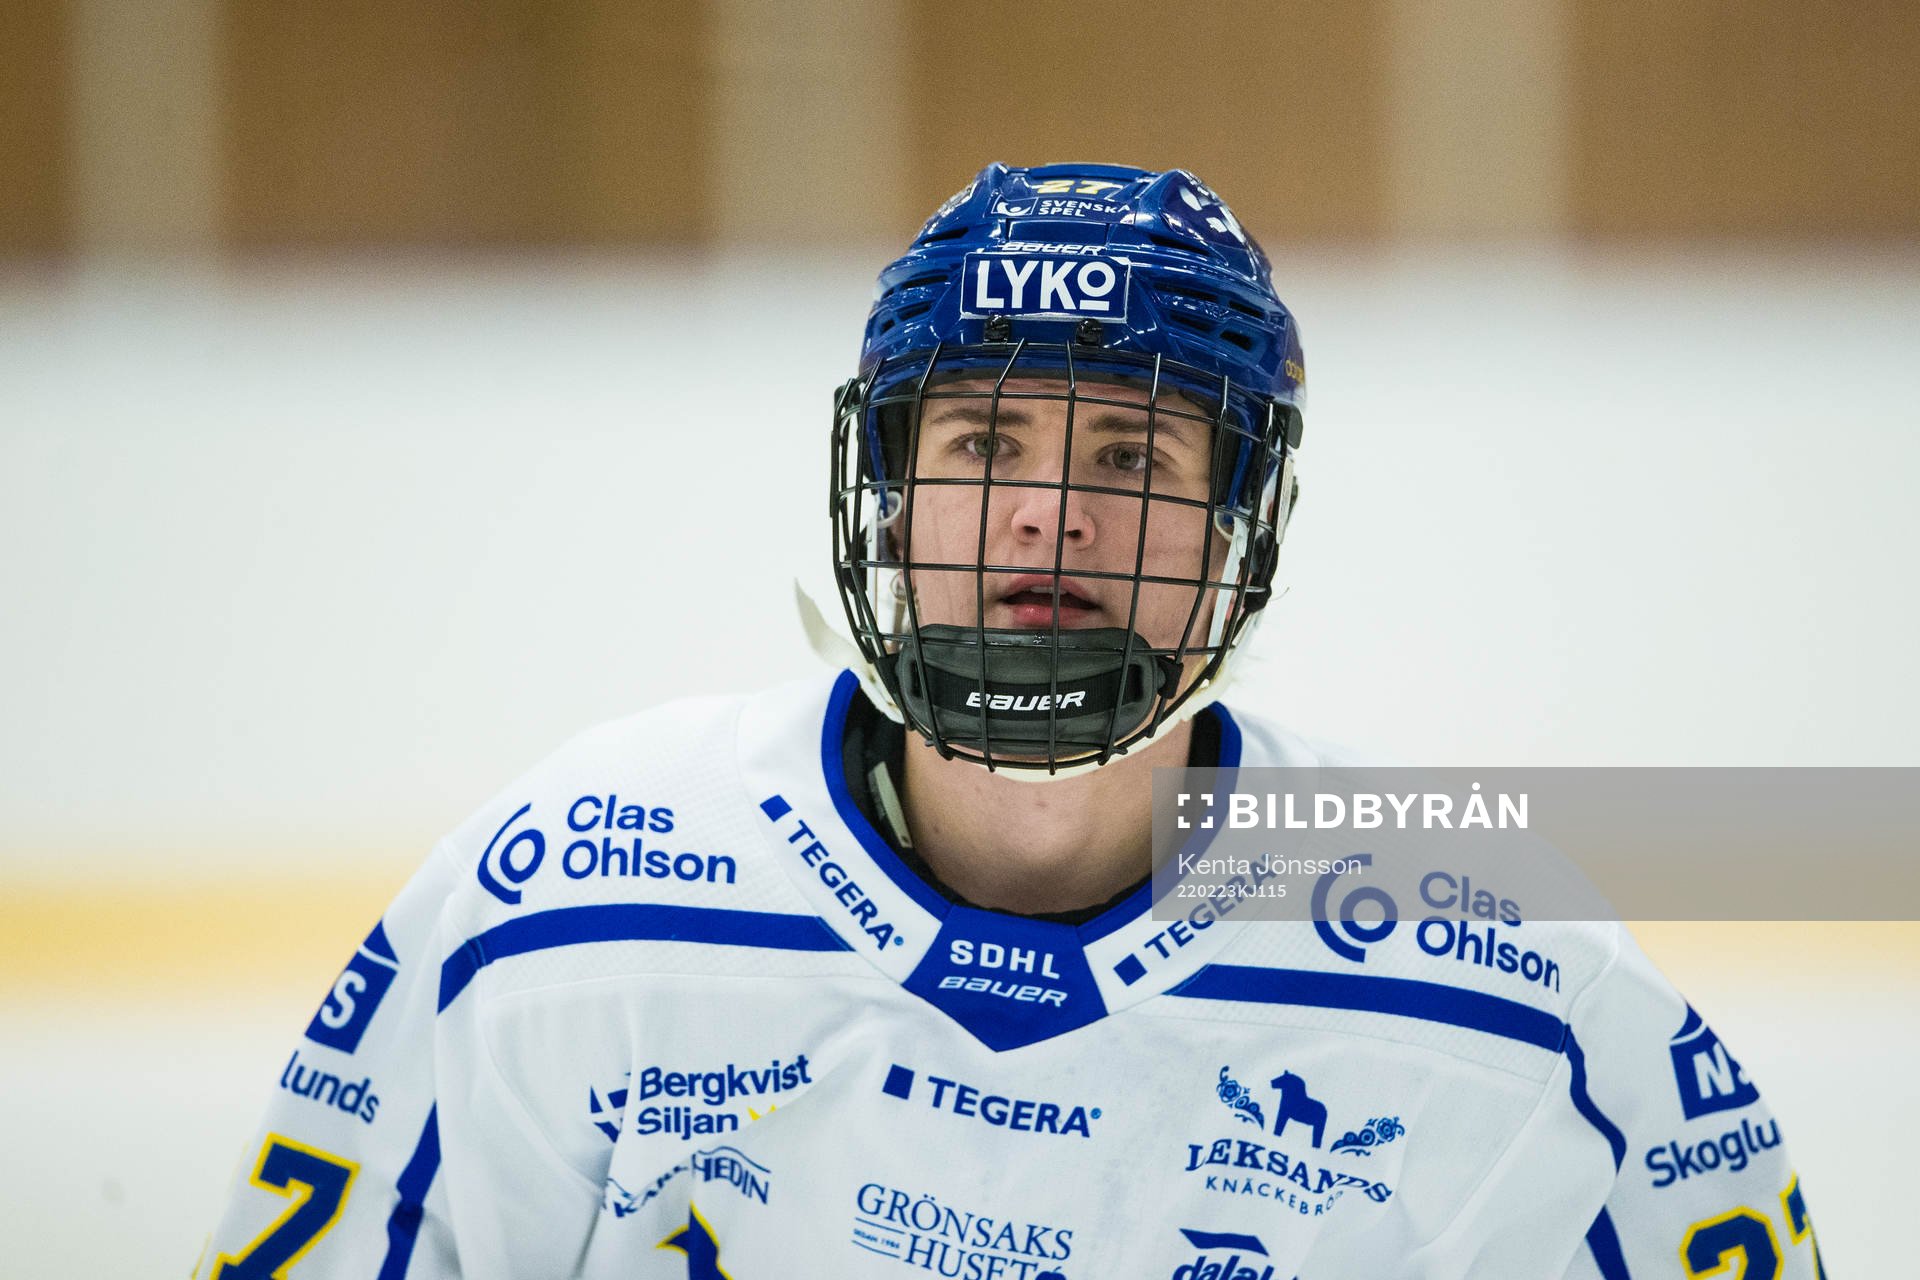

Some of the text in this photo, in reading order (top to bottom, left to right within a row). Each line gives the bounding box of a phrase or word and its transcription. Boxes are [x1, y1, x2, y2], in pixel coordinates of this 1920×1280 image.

[1037, 180, 1114, 195] 27
[1038, 207, 1086, 218] SPEL
[1041, 199, 1131, 214] SVENSKA
[976, 259, 1117, 312] LYKO
[566, 794, 675, 834] Clas
[561, 837, 737, 885] Ohlson
[787, 819, 898, 951] TEGERA
[1418, 870, 1523, 928] Clas
[950, 938, 1061, 980] SDHL
[1415, 915, 1561, 994] Ohlson
[640, 1054, 813, 1107] Bergkvist
[927, 1075, 1092, 1139] TEGERA
[637, 1106, 739, 1141] Siljan
[1185, 1138, 1393, 1204] LEKSANDS
[856, 1182, 1074, 1262] GRÖNSAKS
